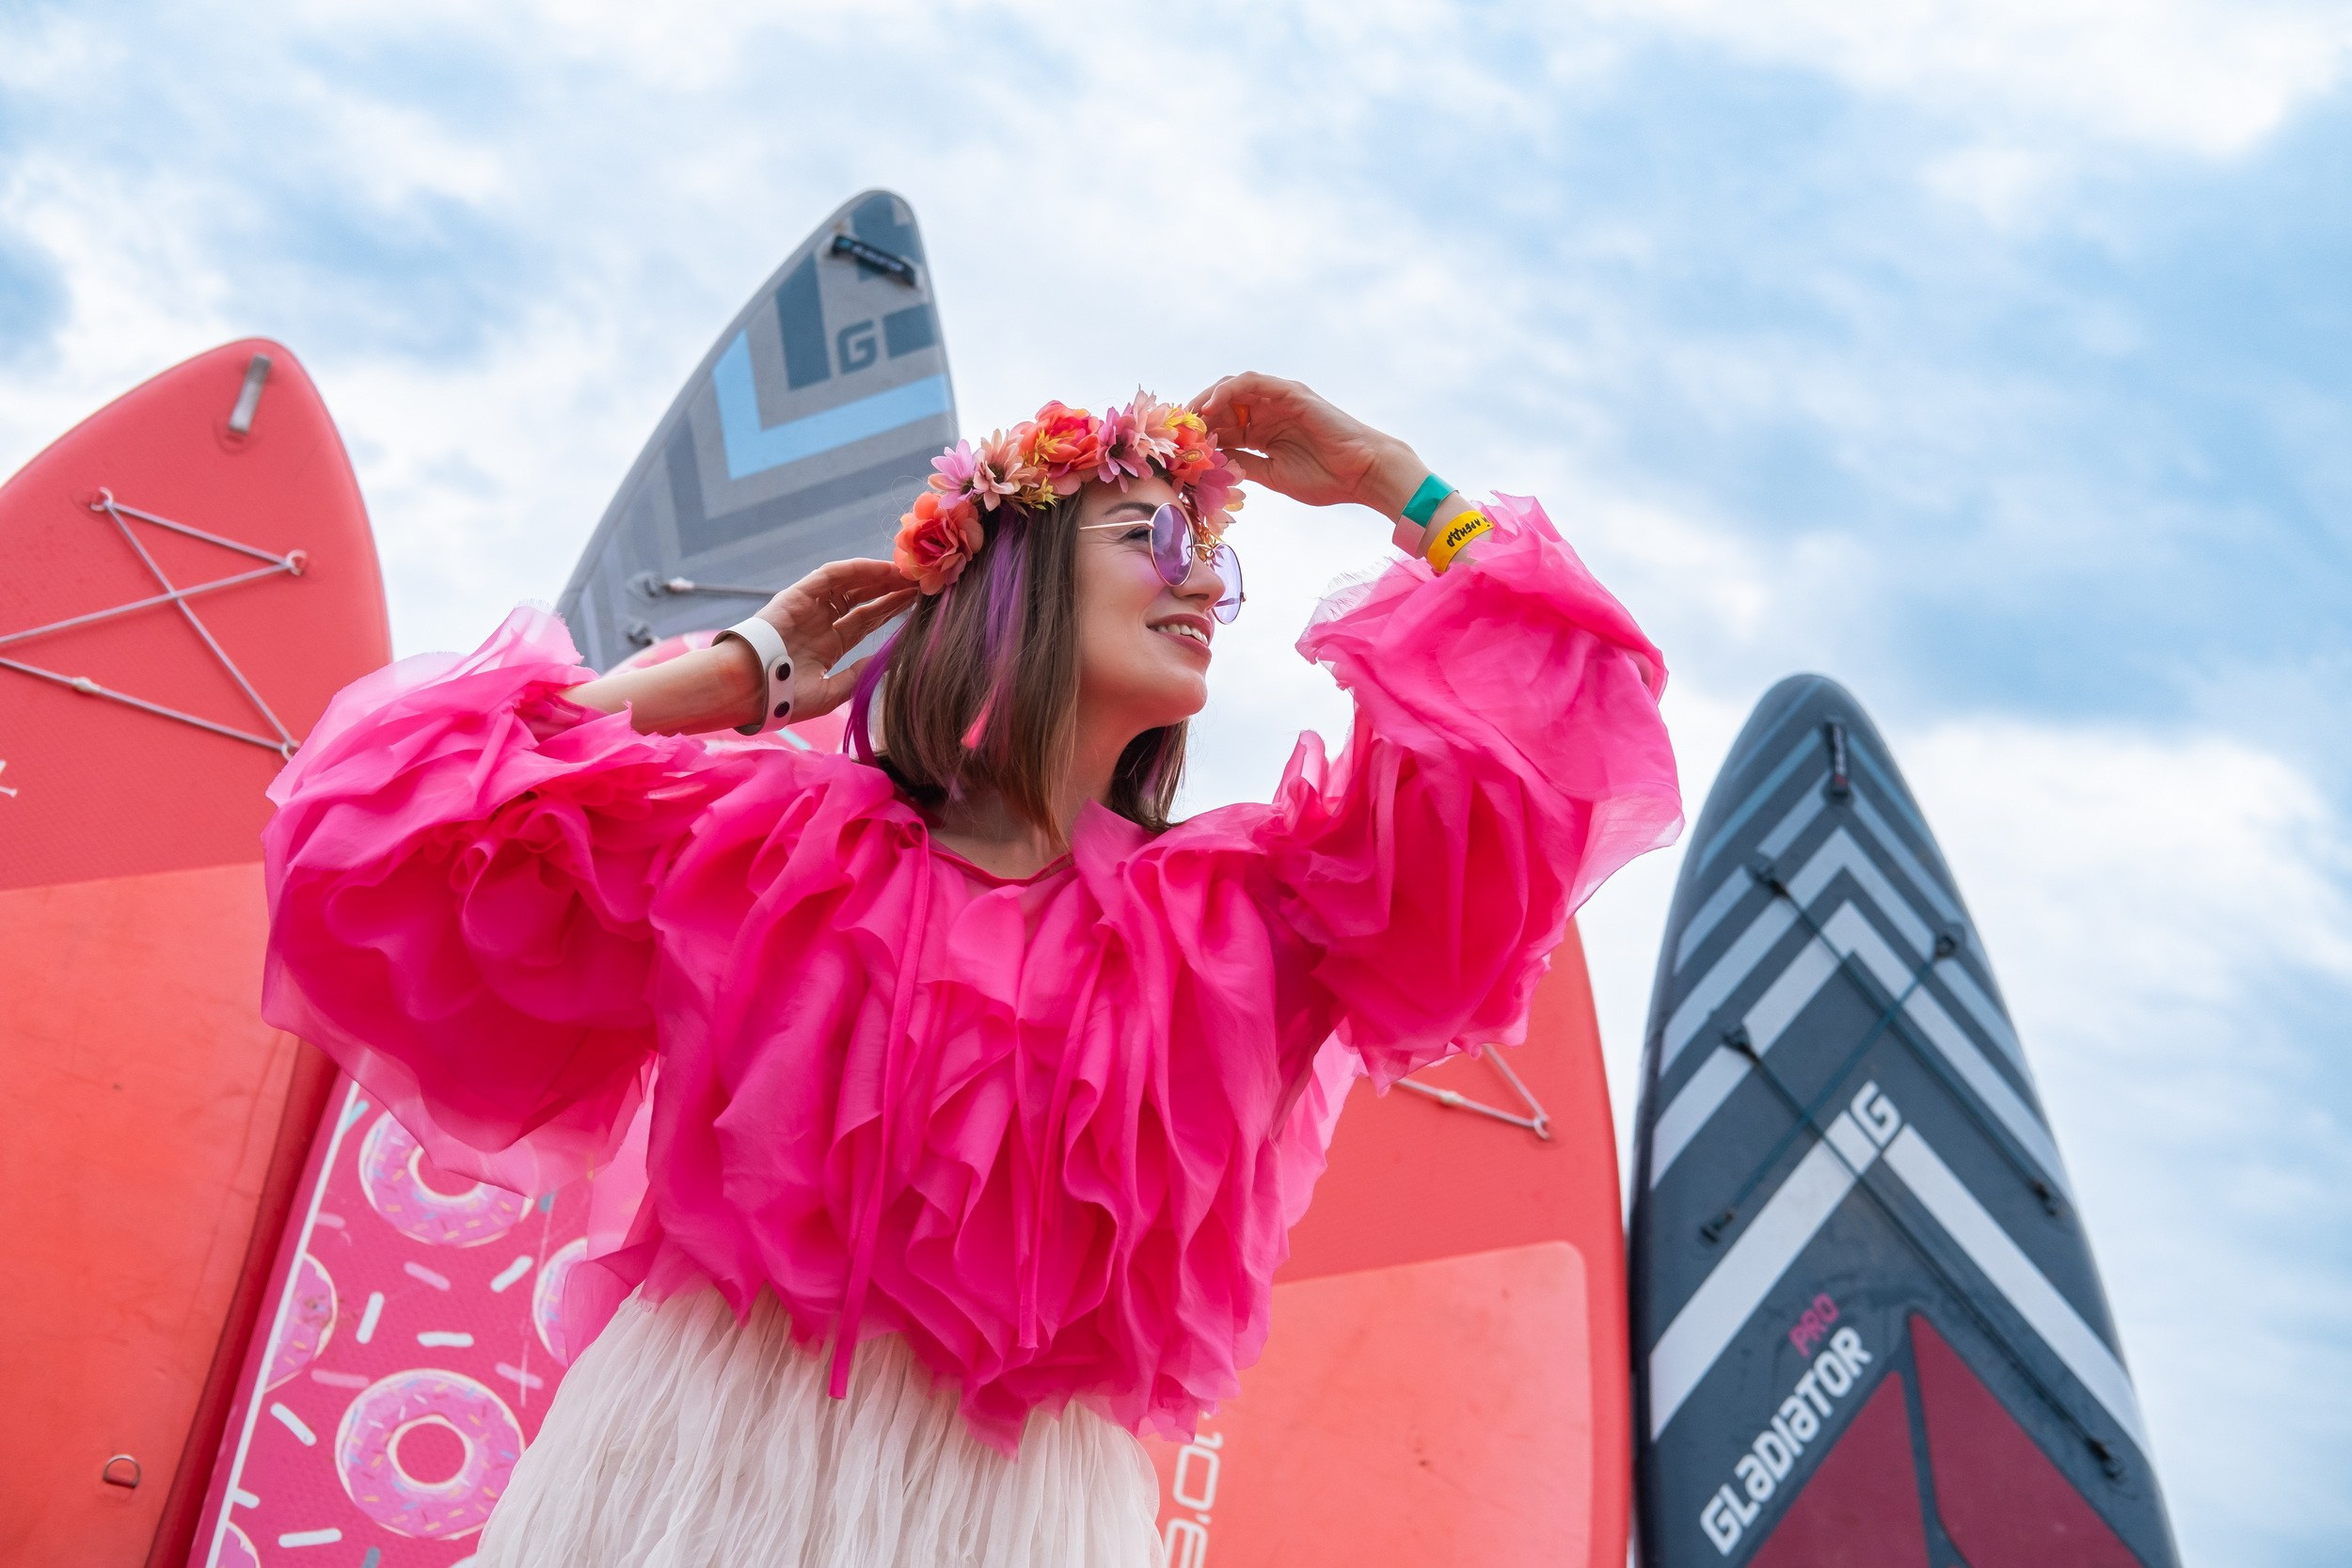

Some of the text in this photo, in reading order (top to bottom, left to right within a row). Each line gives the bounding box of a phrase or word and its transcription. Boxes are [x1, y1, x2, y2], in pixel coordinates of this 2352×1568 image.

[836, 317, 877, 375] G
[1850, 1079, 1901, 1147] G
[1788, 1292, 1839, 1358] PRO
